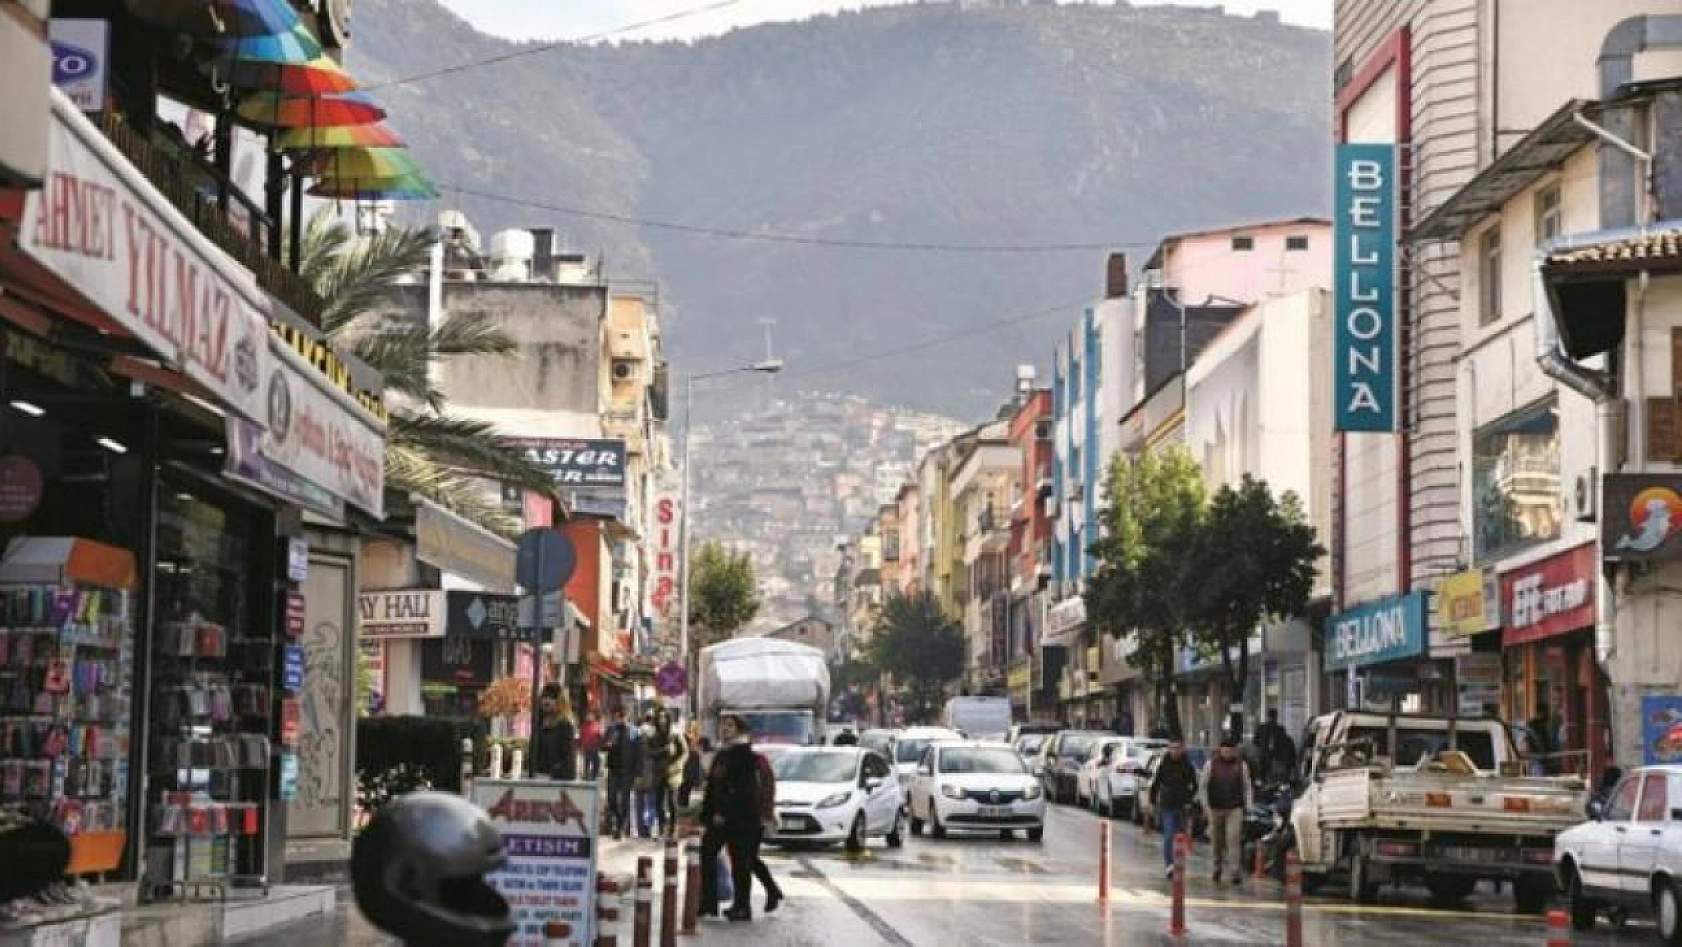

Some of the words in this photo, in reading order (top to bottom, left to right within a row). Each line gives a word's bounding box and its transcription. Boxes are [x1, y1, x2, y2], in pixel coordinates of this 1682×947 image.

[33, 172, 116, 261] AHMET
[121, 201, 231, 384] YILMAZ
[1348, 159, 1383, 414] BELLONA
[1336, 606, 1405, 658] BELLONA
